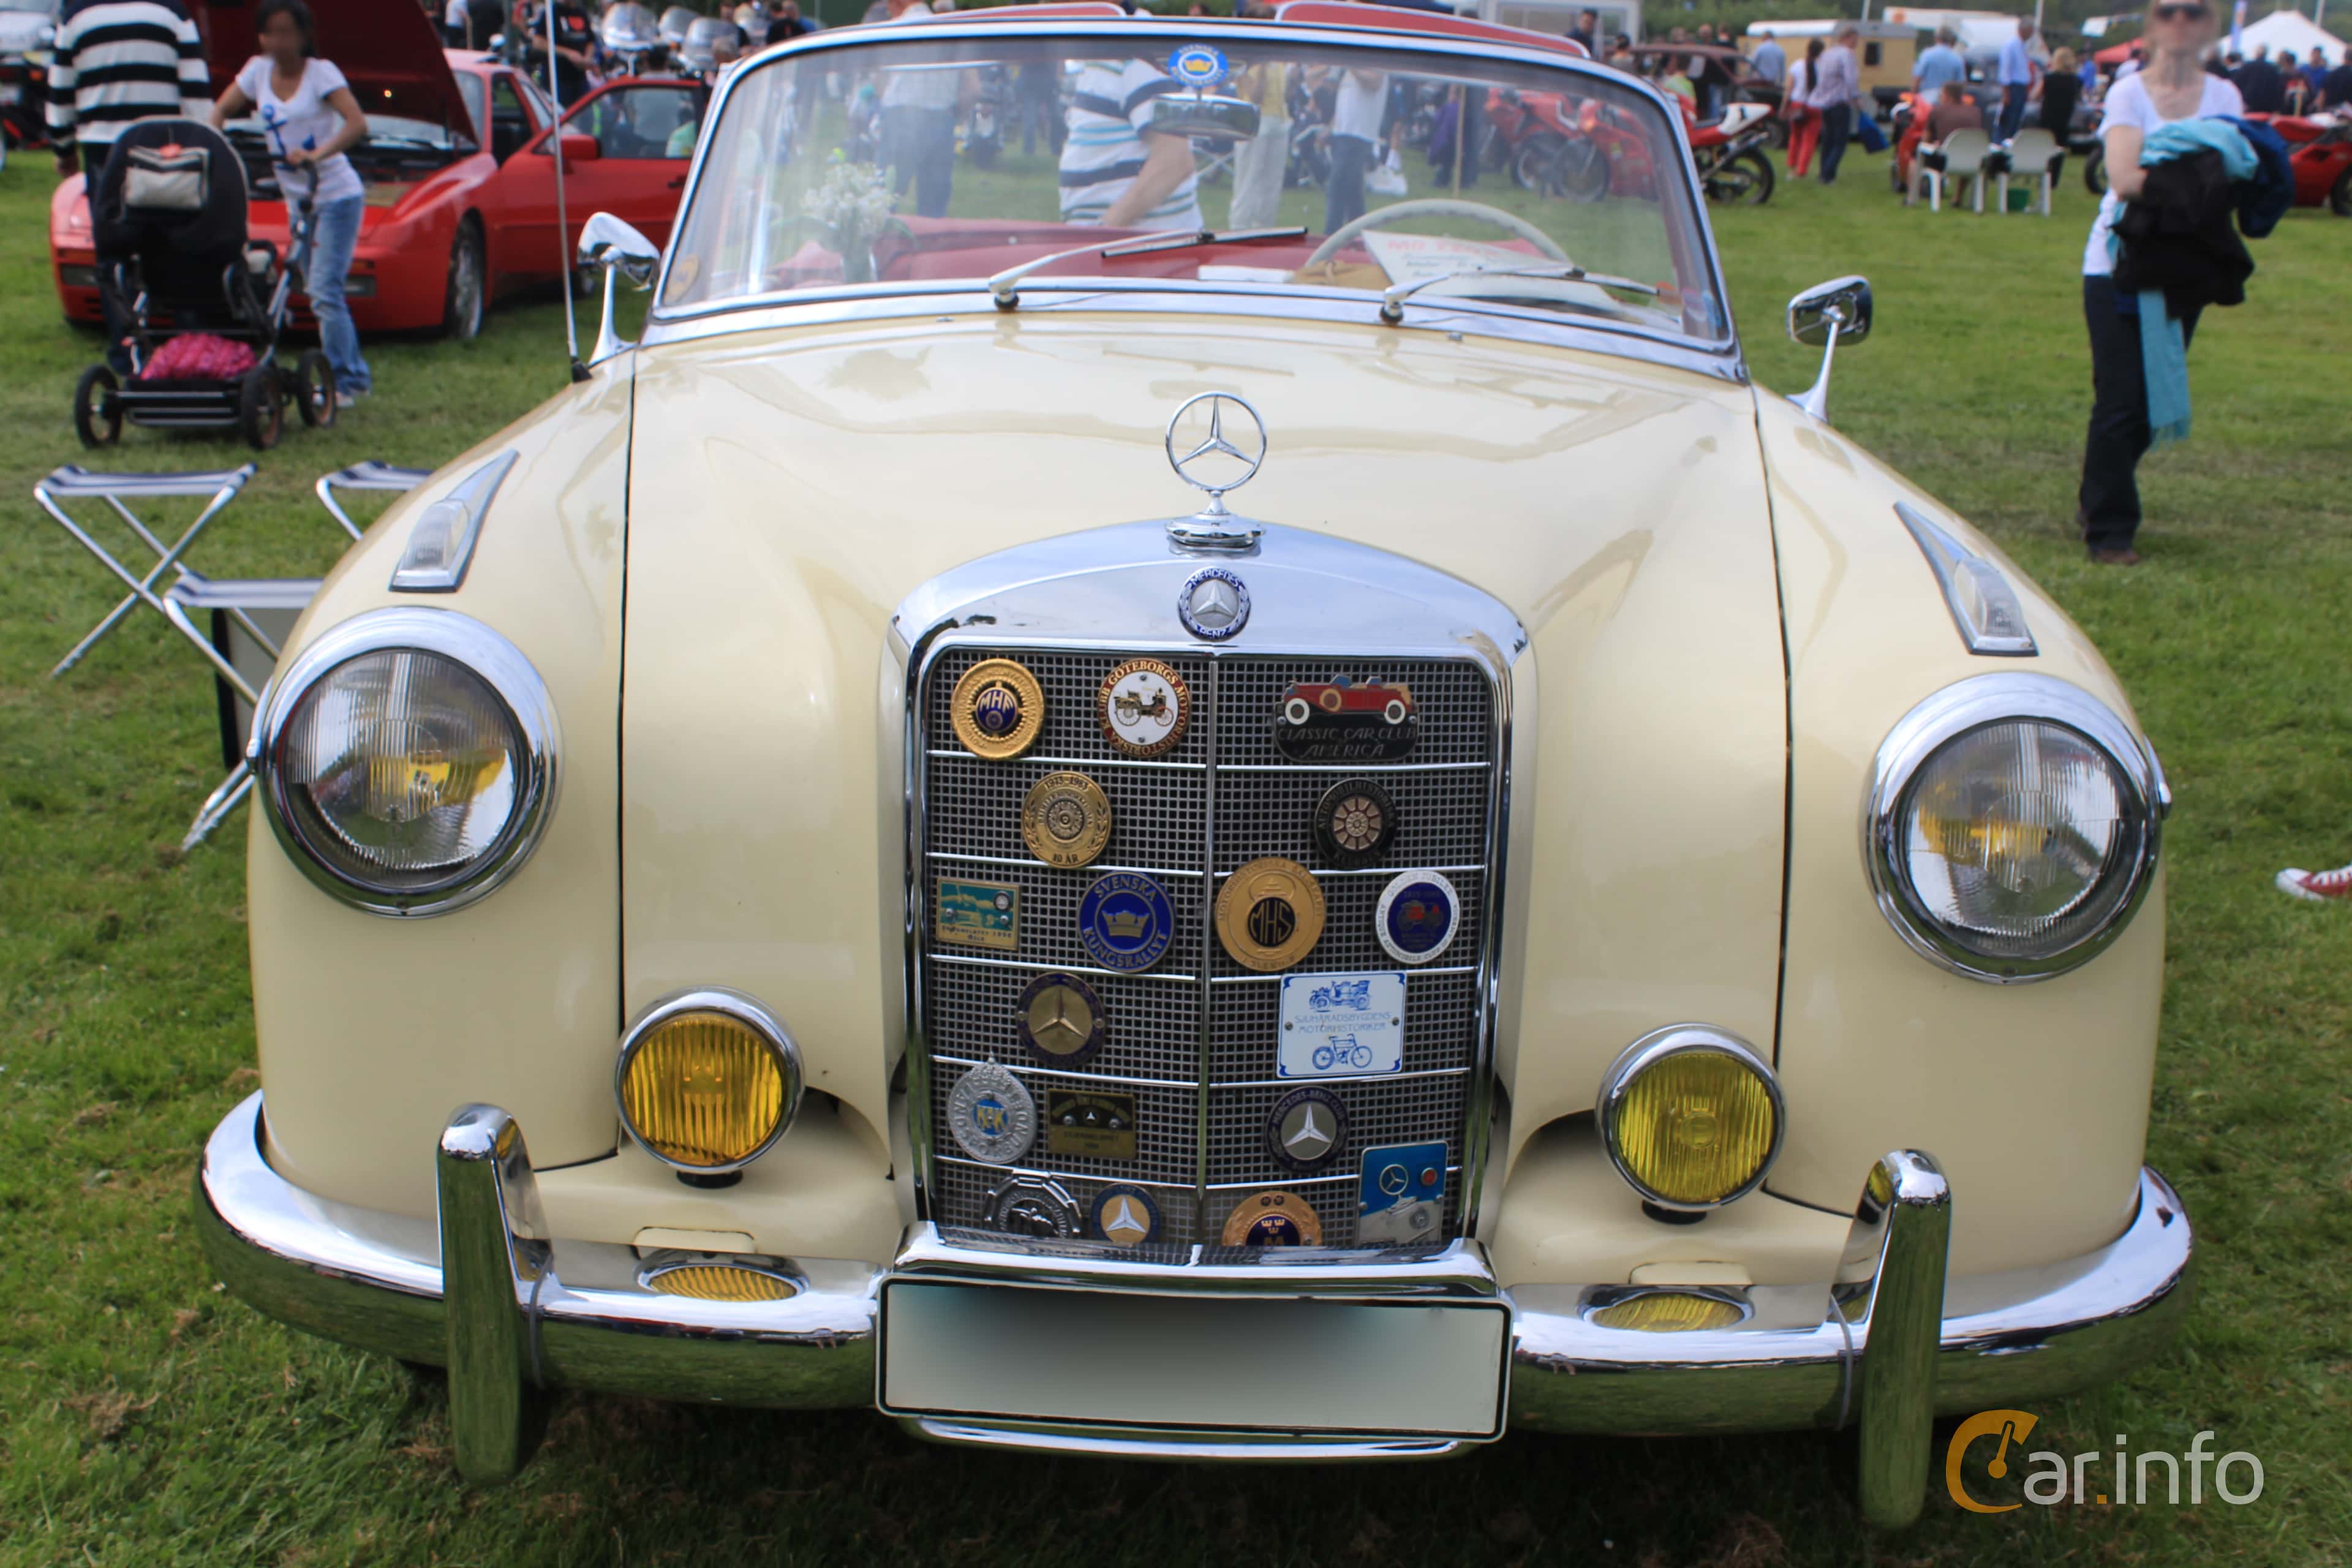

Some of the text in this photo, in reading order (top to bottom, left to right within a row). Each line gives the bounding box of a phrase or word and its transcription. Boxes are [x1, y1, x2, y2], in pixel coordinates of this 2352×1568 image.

[1191, 569, 1238, 587] MERCEDES
[1200, 628, 1229, 637] BENZ
[980, 691, 1014, 714] MHF
[1099, 687, 1112, 729] KLUBB
[1113, 685, 1188, 755] MOTORHISTORISKA
[1278, 726, 1417, 741] CLASSIC CAR CLUB
[1297, 743, 1385, 758] AMERICA
[1054, 853, 1063, 862] 10
[1094, 876, 1156, 902] SVENSKA
[1250, 900, 1292, 944] MHS
[1083, 925, 1167, 968] KUNGSRALLYT
[1298, 1022, 1386, 1034] MOTORHISTORIKER
[1273, 1090, 1333, 1123] MERCEDES-BENZ
